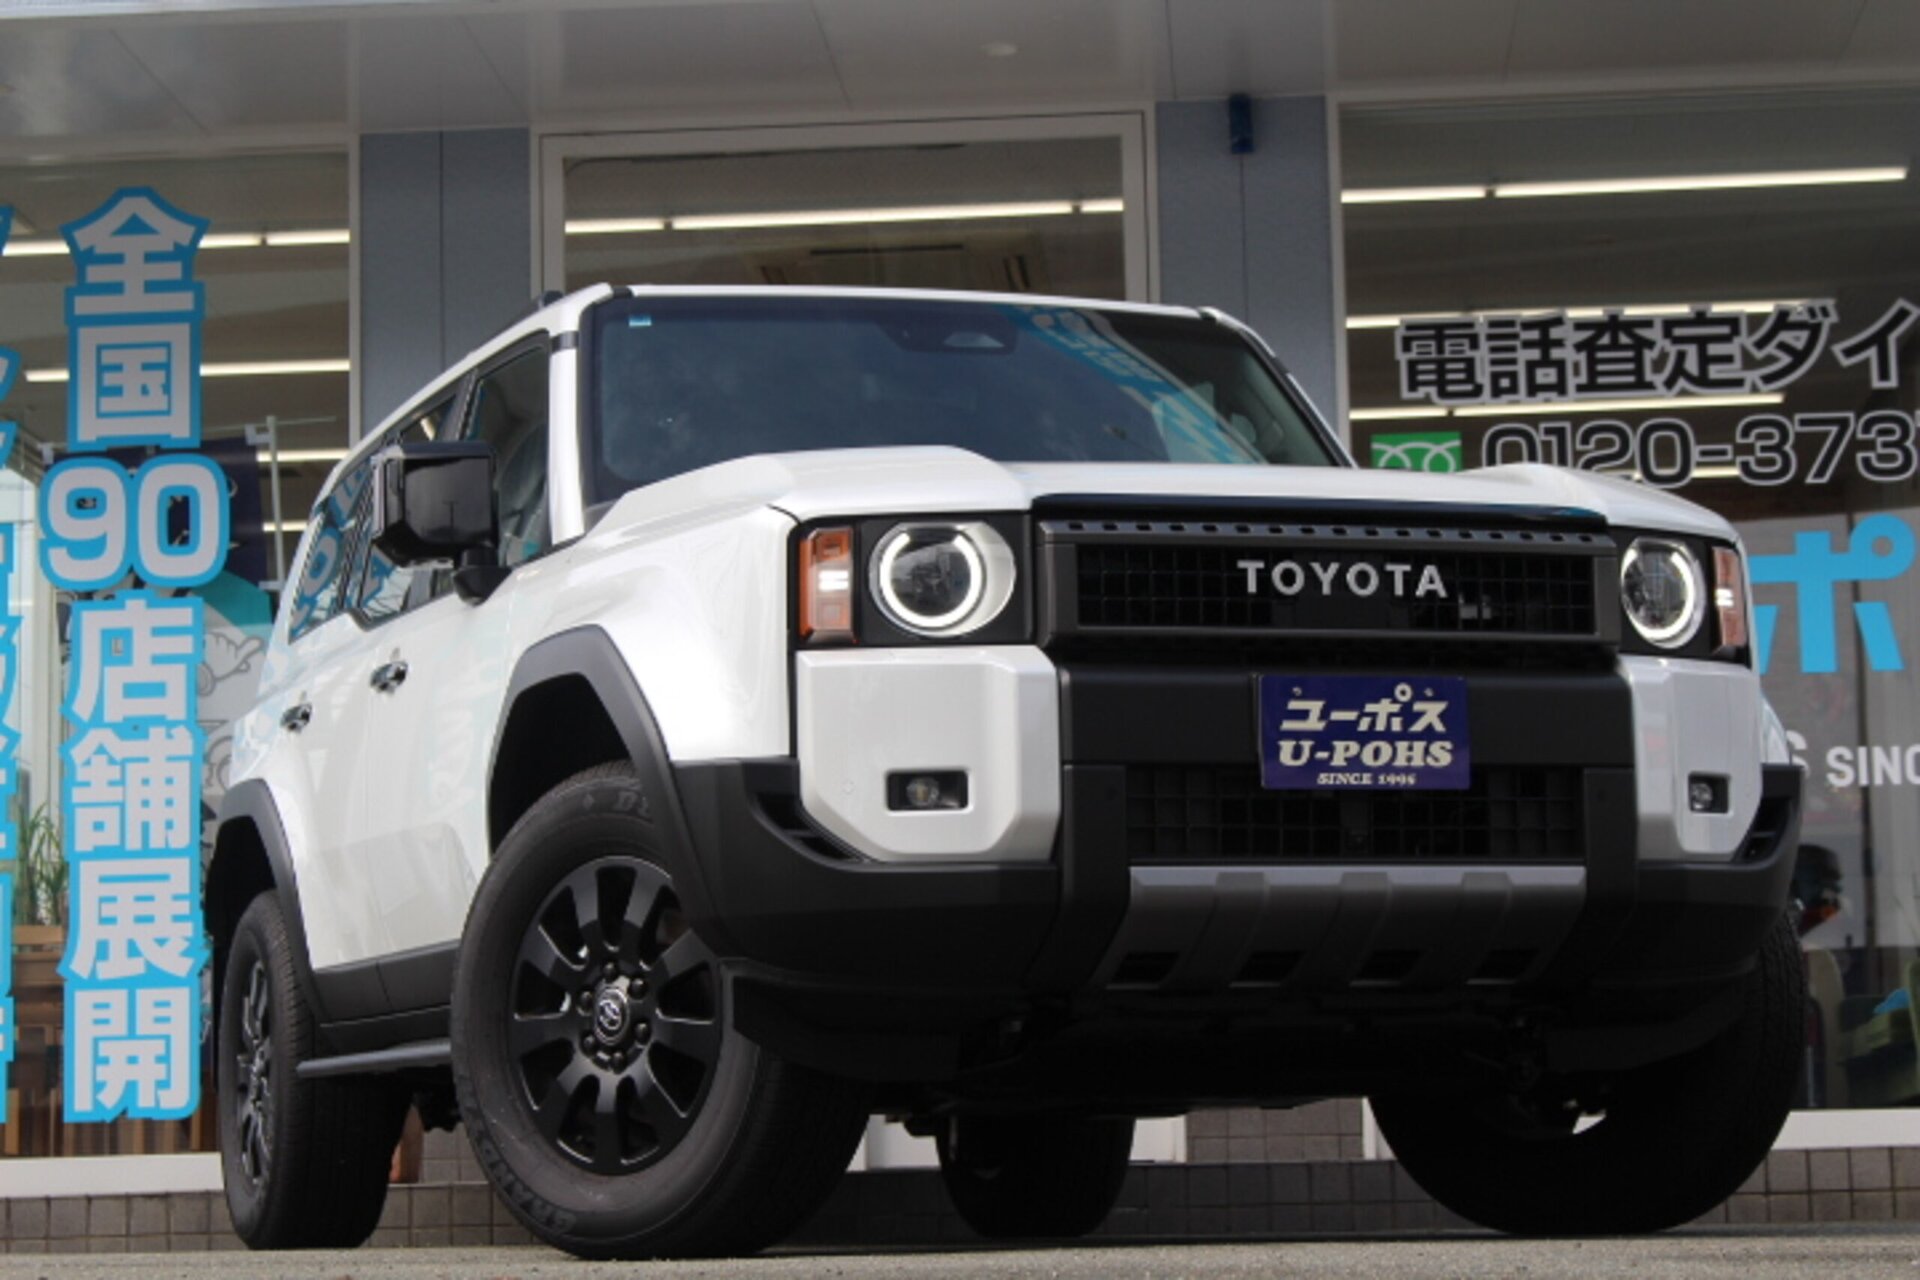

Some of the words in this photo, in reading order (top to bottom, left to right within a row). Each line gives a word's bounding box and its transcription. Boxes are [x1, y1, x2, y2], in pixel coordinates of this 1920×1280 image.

[1395, 299, 1920, 403] 電話査定ダイ
[1482, 409, 1920, 490] 0120-373
[1237, 559, 1448, 599] TOYOTA
[39, 186, 230, 1122] 全国90店舗展開
[1279, 682, 1449, 732] ユーポス
[1277, 740, 1454, 767] U-POHS
[1317, 772, 1373, 785] SINCE
